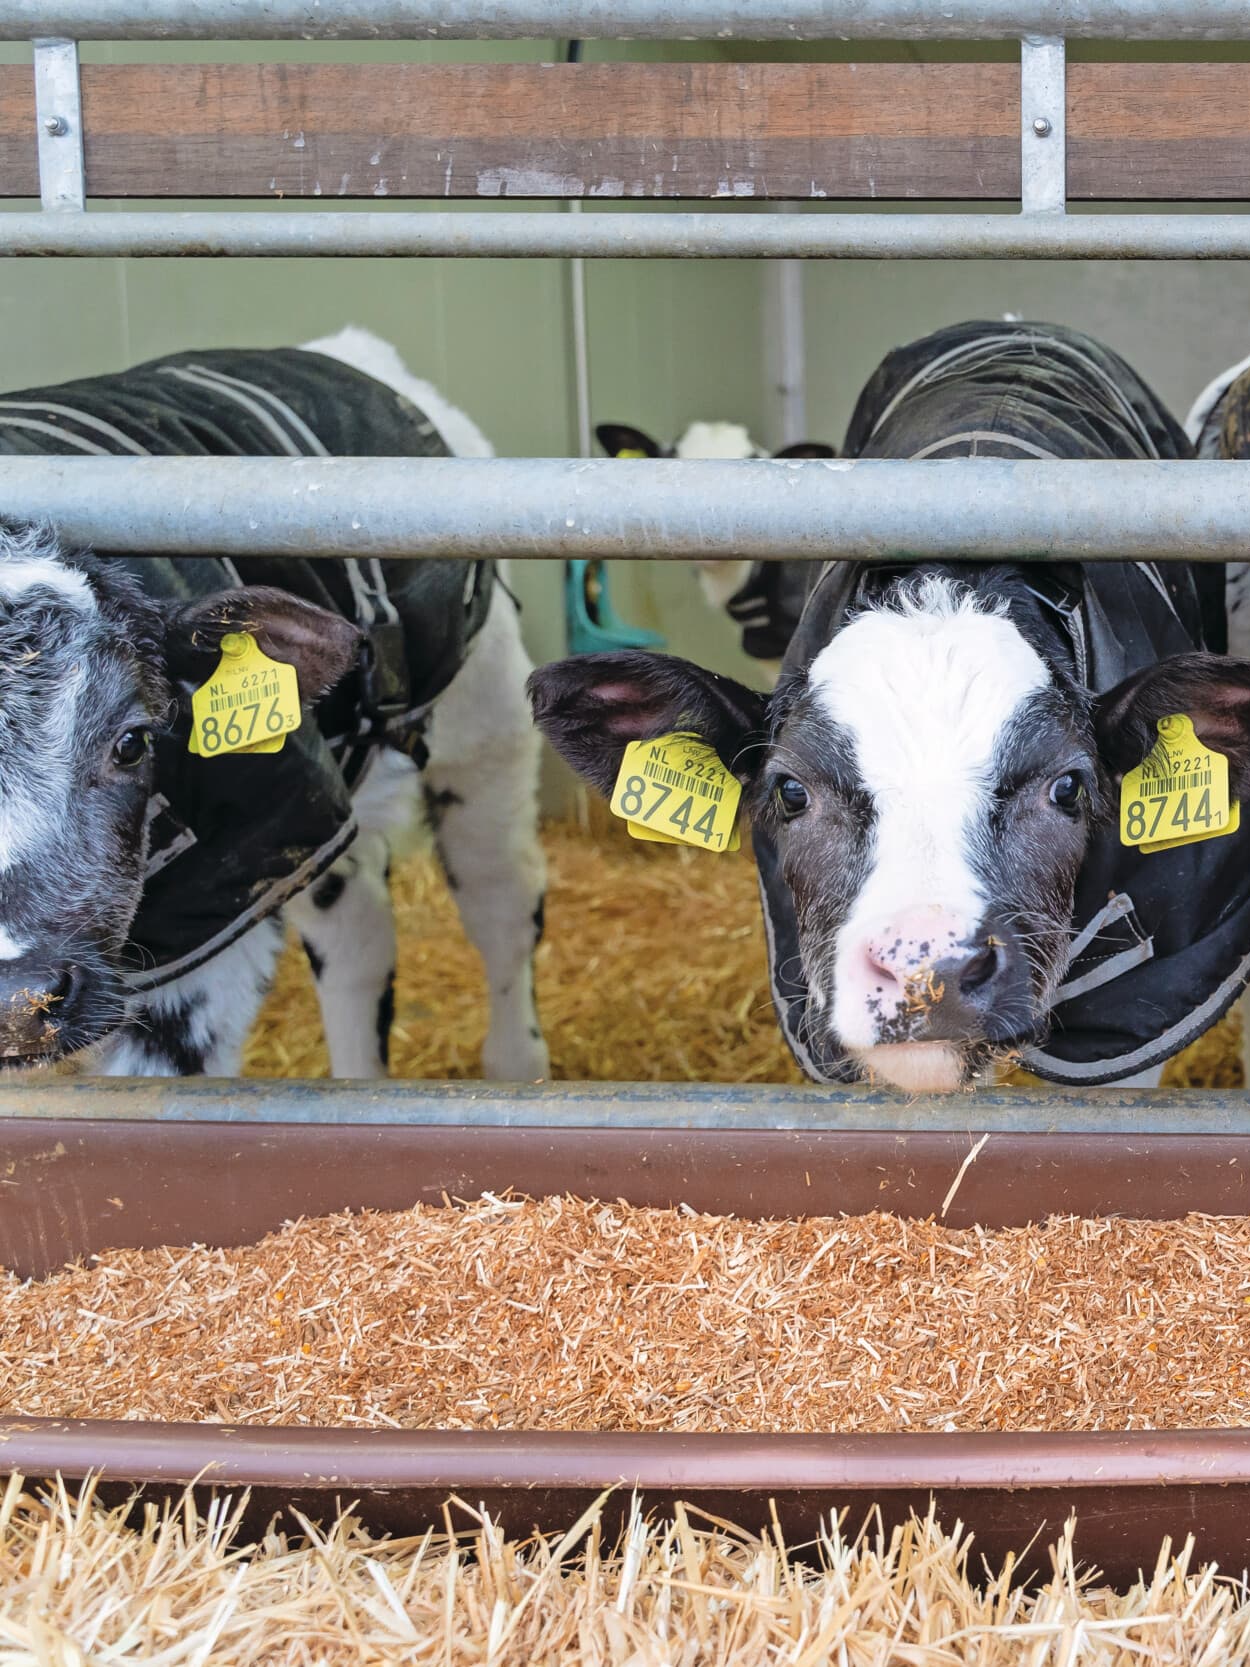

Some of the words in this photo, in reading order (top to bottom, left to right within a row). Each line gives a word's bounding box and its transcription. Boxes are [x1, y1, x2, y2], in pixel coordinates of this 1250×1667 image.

[210, 683, 228, 697] NL
[241, 668, 278, 689] 6271
[649, 745, 670, 766] NL
[683, 759, 727, 784] 9221
[1142, 765, 1160, 780] NL
[1172, 754, 1211, 775] 9221
